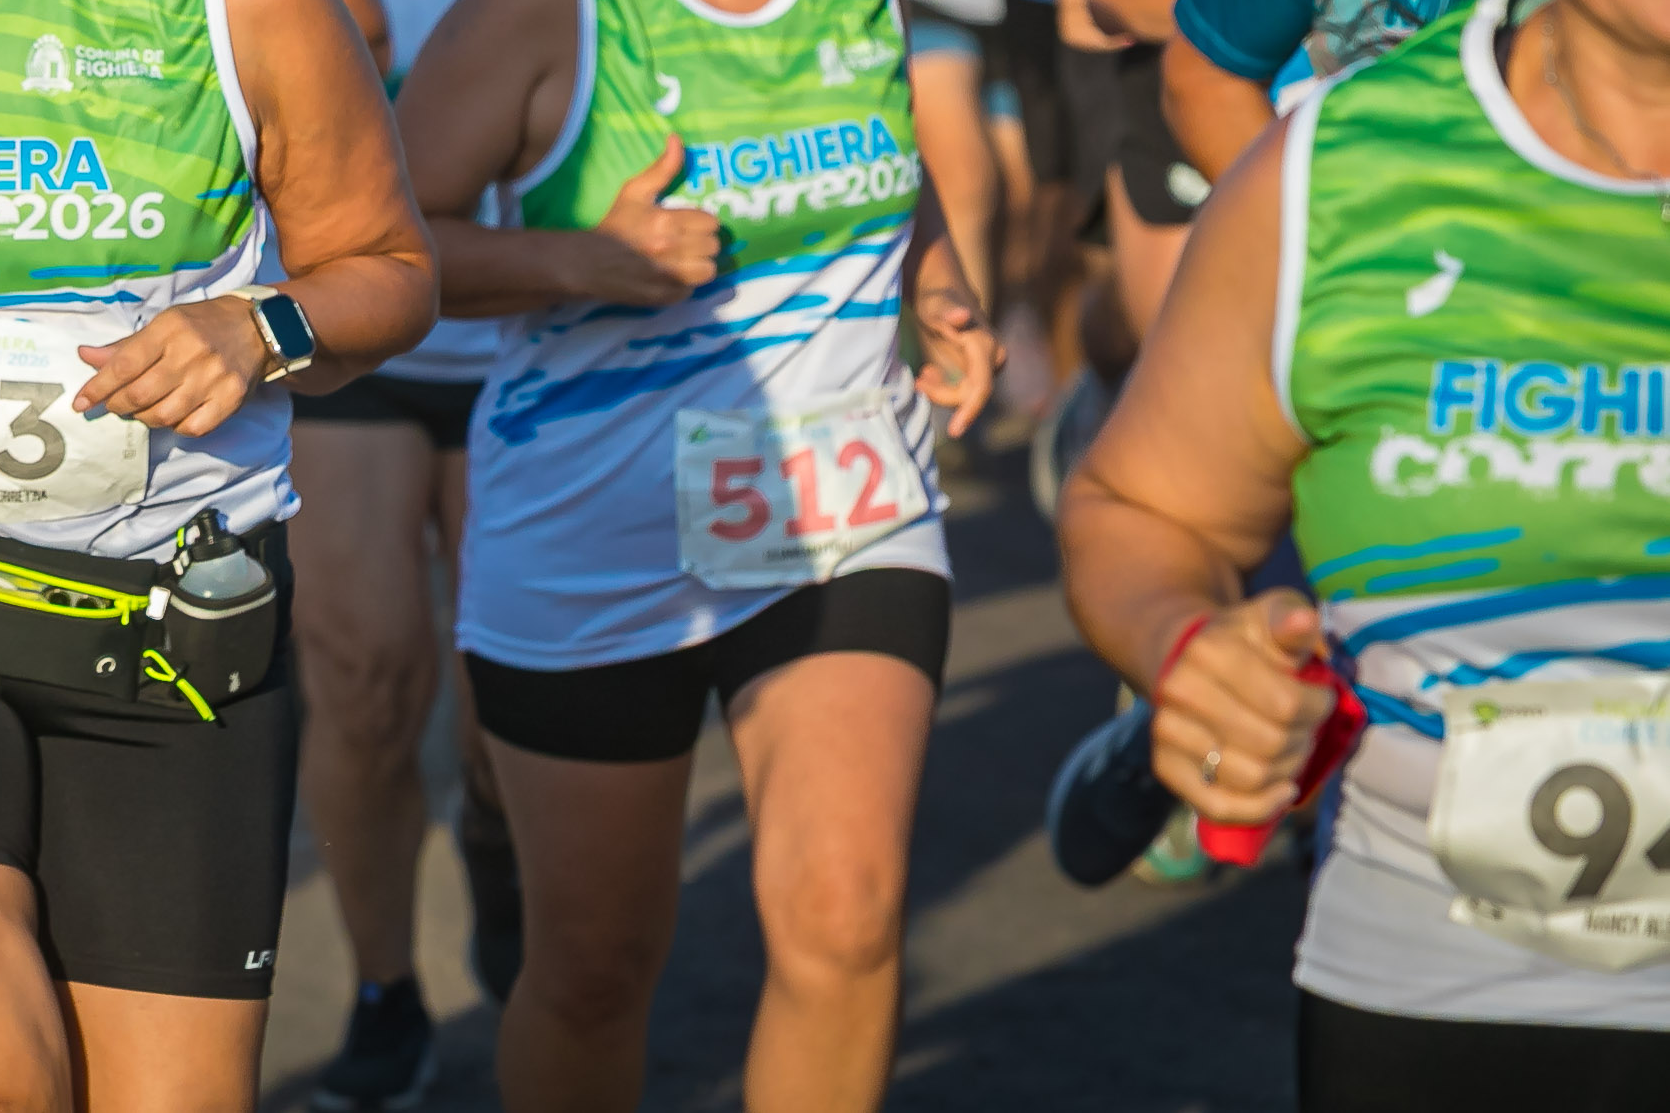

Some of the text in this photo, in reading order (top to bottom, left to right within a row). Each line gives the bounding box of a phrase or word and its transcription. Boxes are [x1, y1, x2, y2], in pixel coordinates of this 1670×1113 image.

[142, 48, 165, 64] DE
[684, 114, 900, 194] FIGHIERA
[707, 439, 899, 543] 512
[1530, 762, 1670, 902] 9
